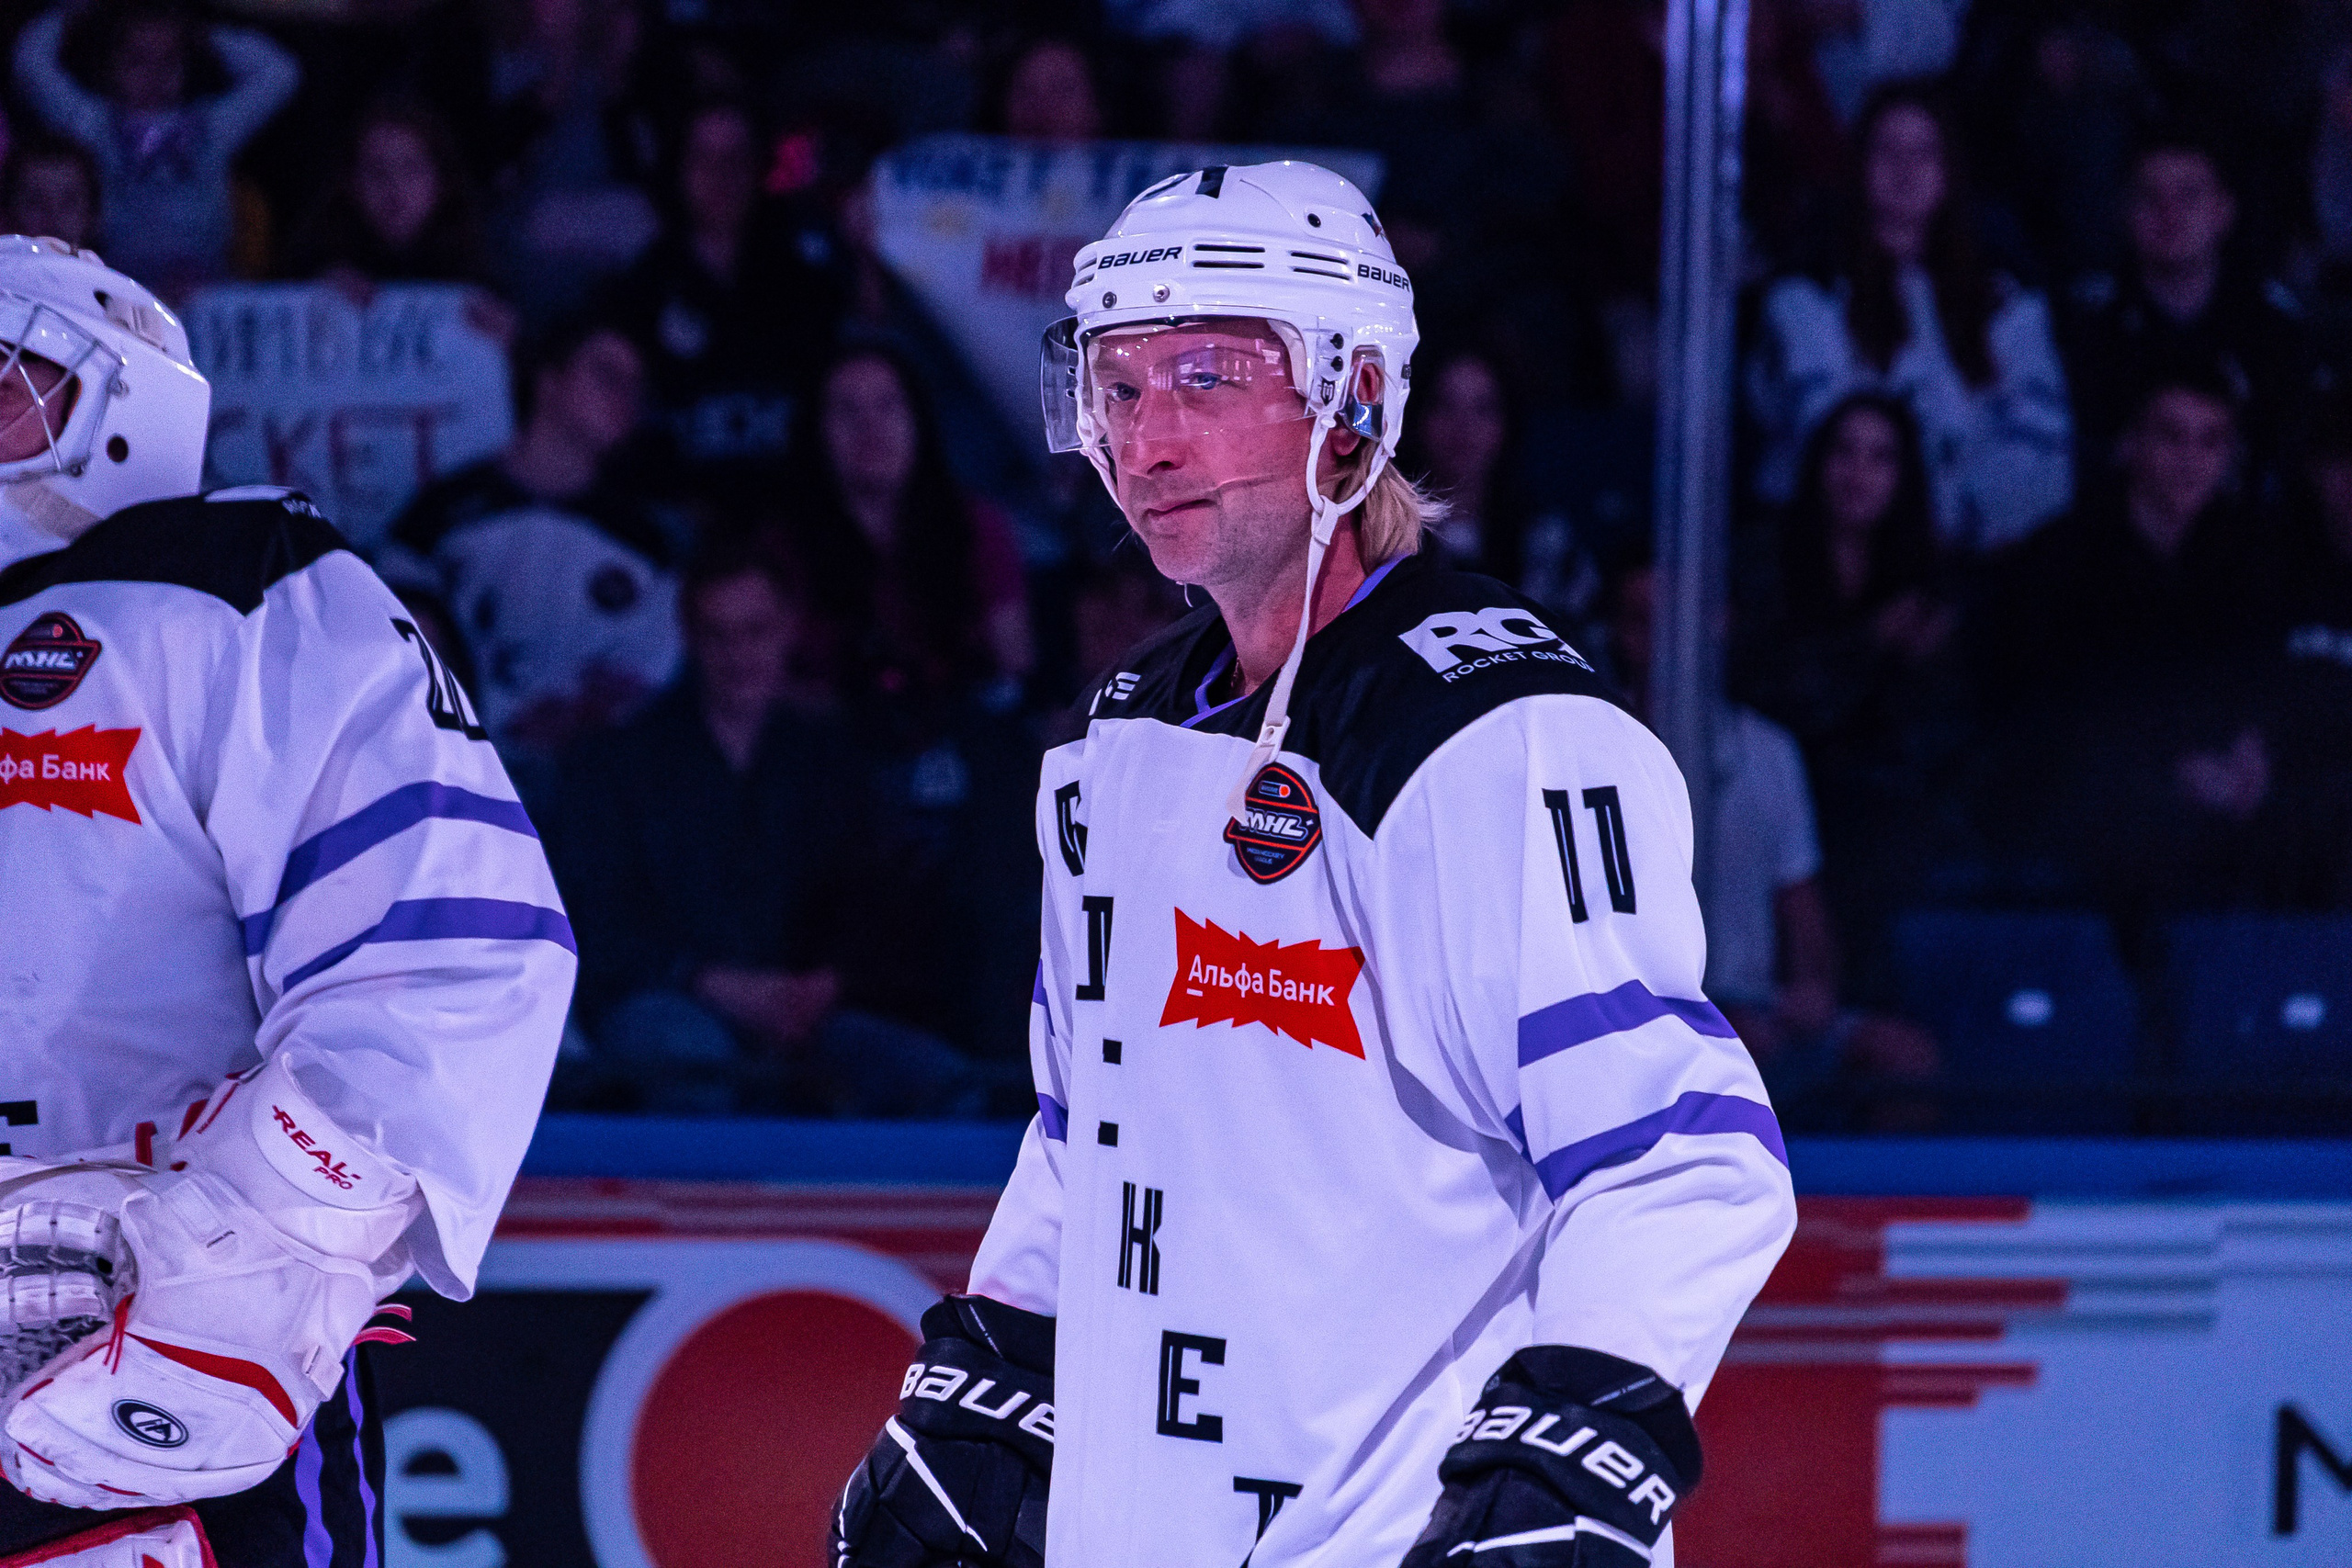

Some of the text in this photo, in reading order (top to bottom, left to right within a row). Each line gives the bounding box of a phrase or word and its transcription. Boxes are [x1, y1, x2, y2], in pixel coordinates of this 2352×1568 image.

[1098, 246, 1182, 270] BAUER
[1357, 263, 1410, 293] BAUER
[1442, 650, 1527, 683] ROCKET
[42, 753, 111, 781] Банк
[1542, 784, 1637, 924] 11
[1187, 953, 1335, 1007] Альфа Банк
[312, 1165, 353, 1190] PRO
